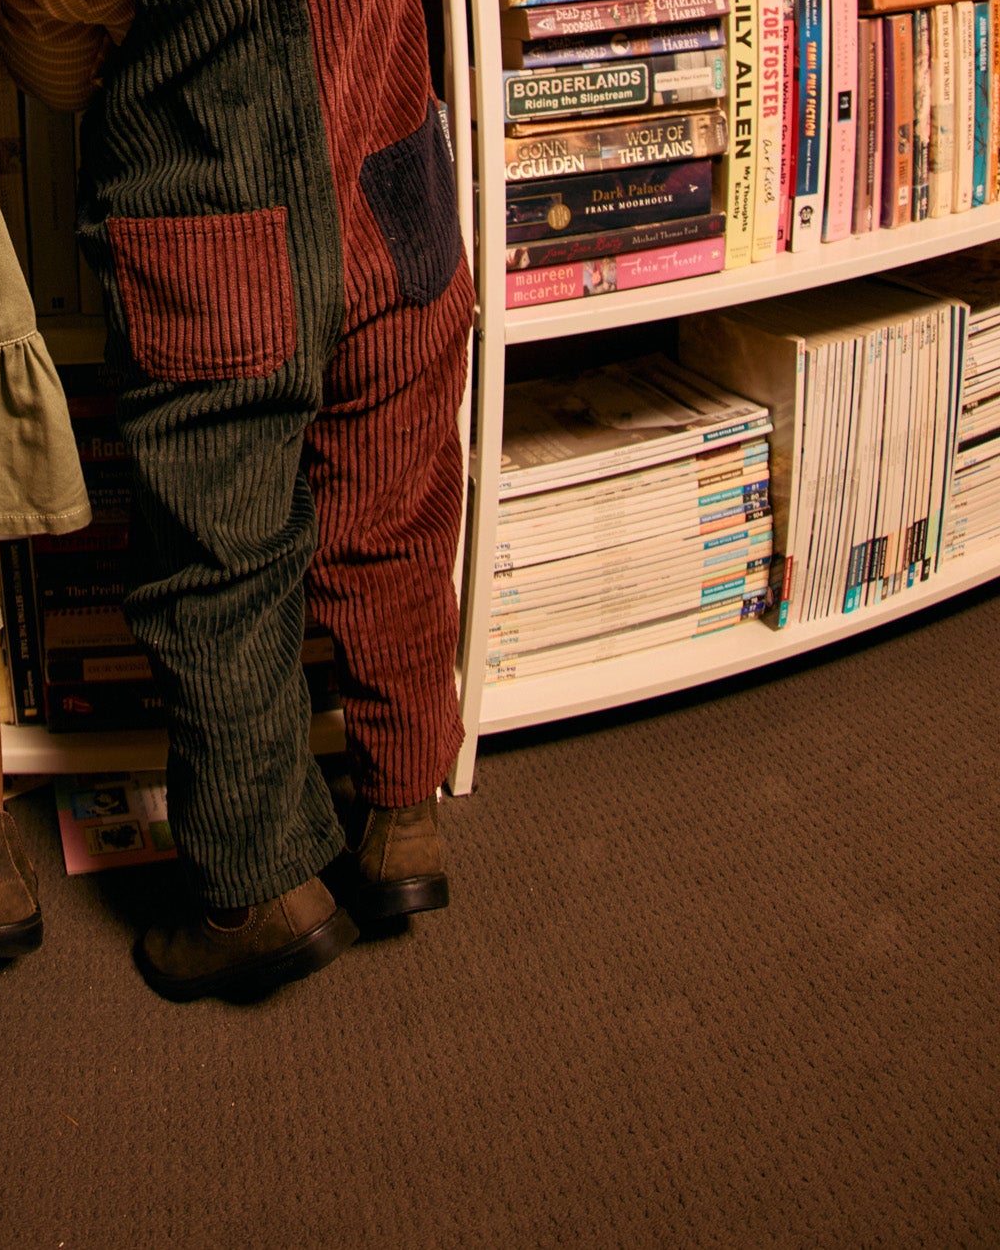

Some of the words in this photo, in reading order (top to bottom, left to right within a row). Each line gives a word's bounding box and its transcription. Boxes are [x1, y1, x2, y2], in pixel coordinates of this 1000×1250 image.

[668, 5, 707, 22] HARRIS
[661, 36, 700, 52] HARRIS
[805, 40, 817, 71] TAMIL
[512, 70, 642, 99] BORDERLANDS
[761, 45, 780, 120] FOSTER
[805, 72, 817, 97] PULP
[524, 96, 559, 110] Riding
[560, 94, 578, 106] the
[579, 88, 633, 107] Slipstream
[733, 60, 753, 160] ALLEN
[804, 98, 816, 137] FICTION
[517, 138, 568, 161] CONN
[625, 128, 664, 146] WOLF
[666, 124, 685, 141] OF
[617, 147, 645, 164] THE
[646, 139, 694, 161] PLAINS
[585, 203, 616, 215] FRANK
[617, 194, 674, 210] MOORHOUSE
[591, 185, 625, 203] Dark
[732, 181, 742, 220] Exactly
[741, 182, 752, 232] Thoughts
[515, 266, 575, 287] maureen
